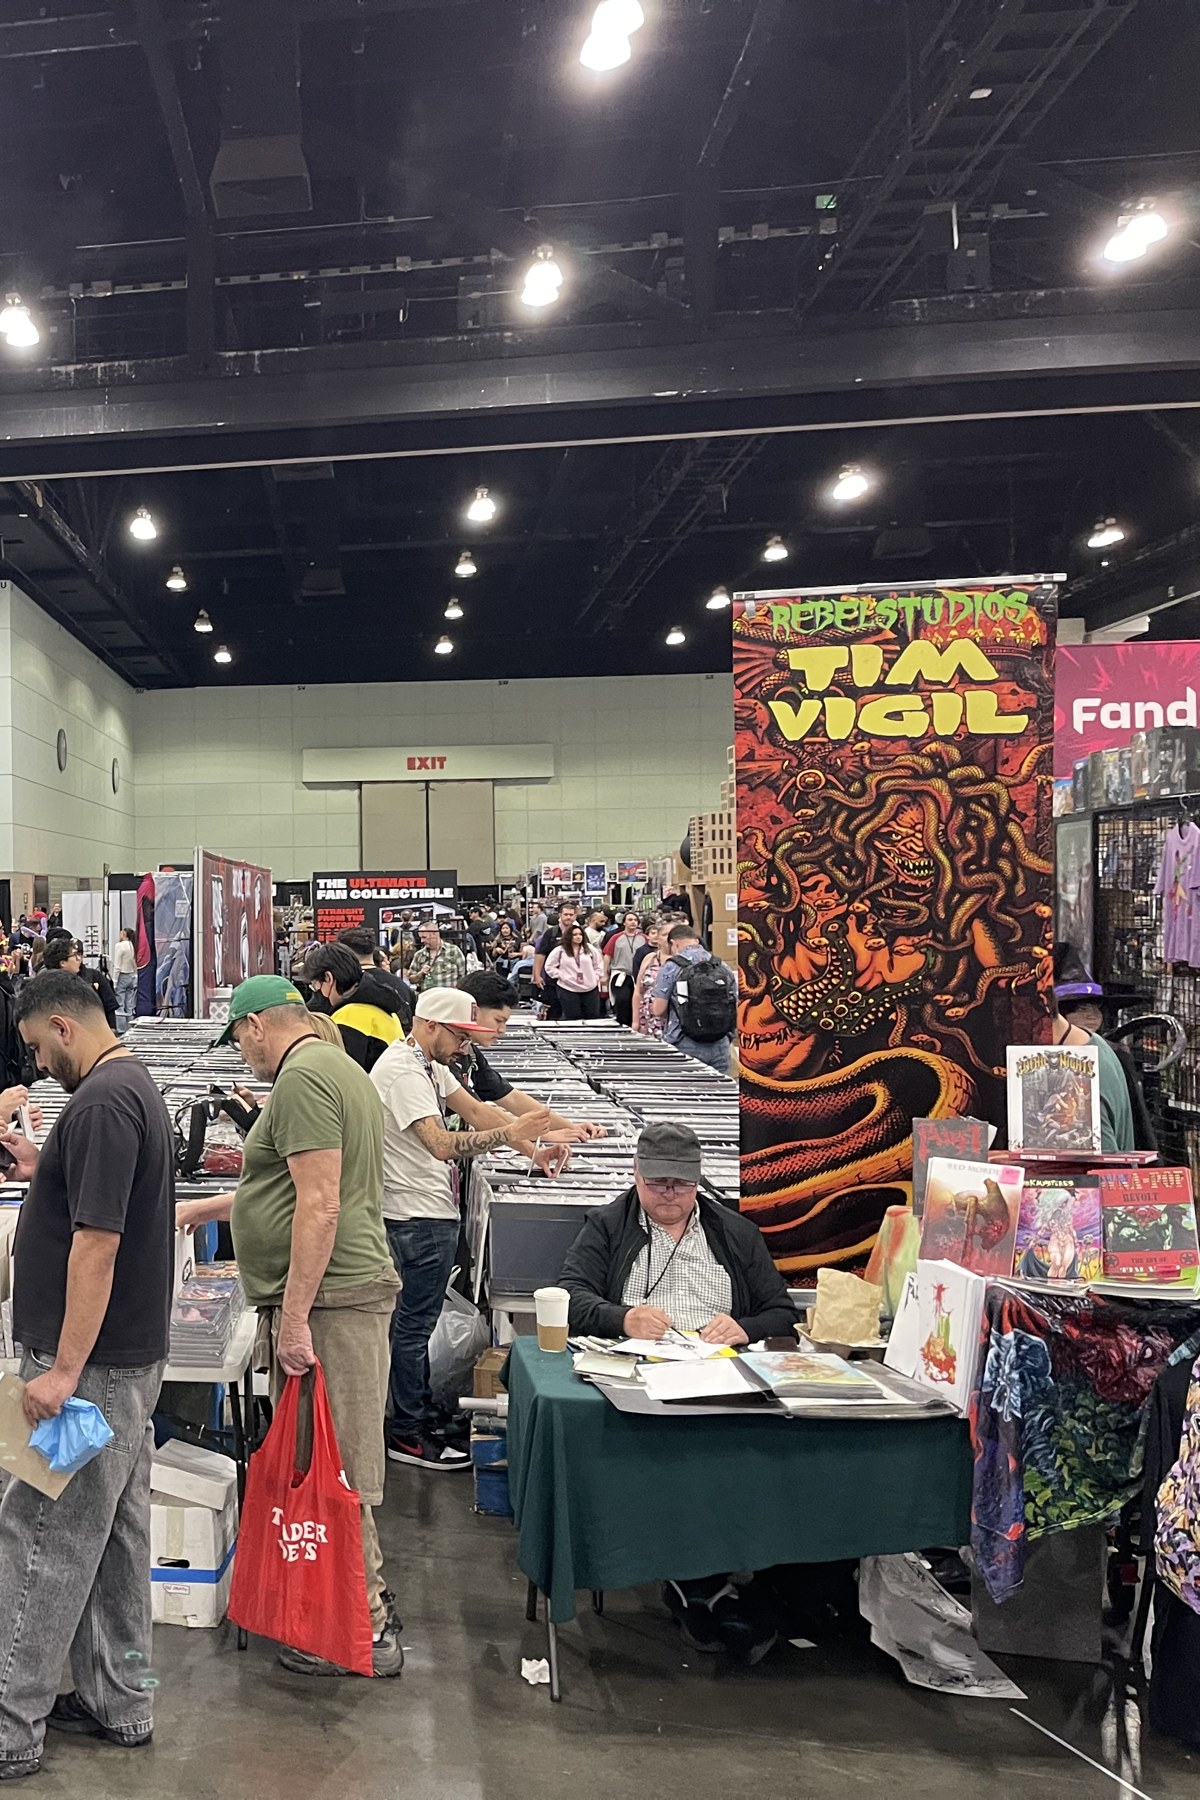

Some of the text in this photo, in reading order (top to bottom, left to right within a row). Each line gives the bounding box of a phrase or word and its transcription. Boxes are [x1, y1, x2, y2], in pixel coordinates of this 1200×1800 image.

[787, 637, 999, 692] TIM
[767, 690, 1029, 741] VIGIL
[1073, 686, 1197, 734] Fand
[407, 757, 446, 770] EXIT
[316, 877, 427, 888] THE ULTIMATE
[316, 888, 454, 900] FAN COLLECTIBLE
[271, 1506, 329, 1543] TDER
